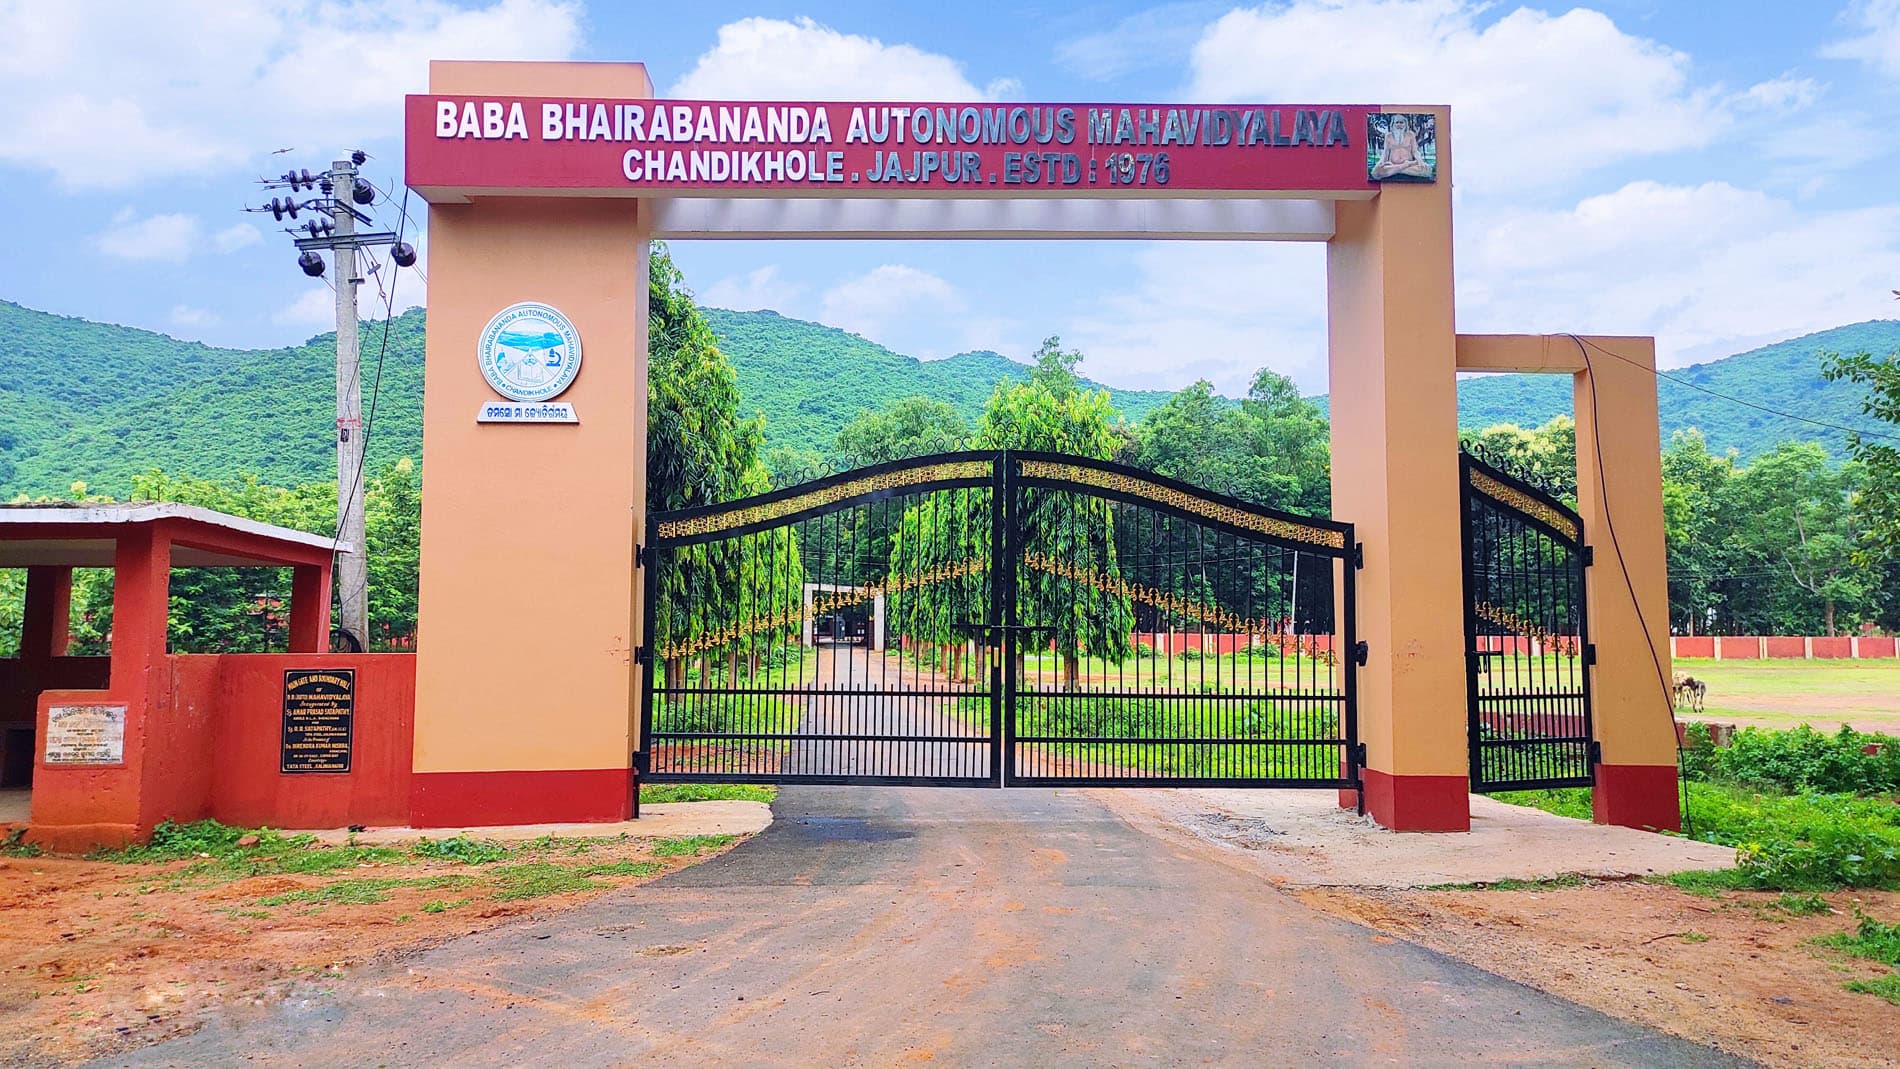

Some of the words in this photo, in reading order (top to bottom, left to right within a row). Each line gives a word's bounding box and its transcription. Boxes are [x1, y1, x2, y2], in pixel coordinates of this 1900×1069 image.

[436, 101, 528, 139] BABA
[542, 103, 832, 143] BHAIRABANANDA
[846, 106, 1076, 146] AUTONOMOUS
[1087, 108, 1350, 148] MAHAVIDYALAYA
[866, 150, 981, 184] JAJPUR
[1105, 152, 1170, 184] 1976
[518, 309, 566, 331] AUTONOMOUS
[484, 314, 517, 366] BHAIRABANANDA
[556, 330, 576, 385] MAHAVIDYALAYA
[488, 366, 503, 387] BABA
[505, 384, 553, 396] CHANDIKHOLE
